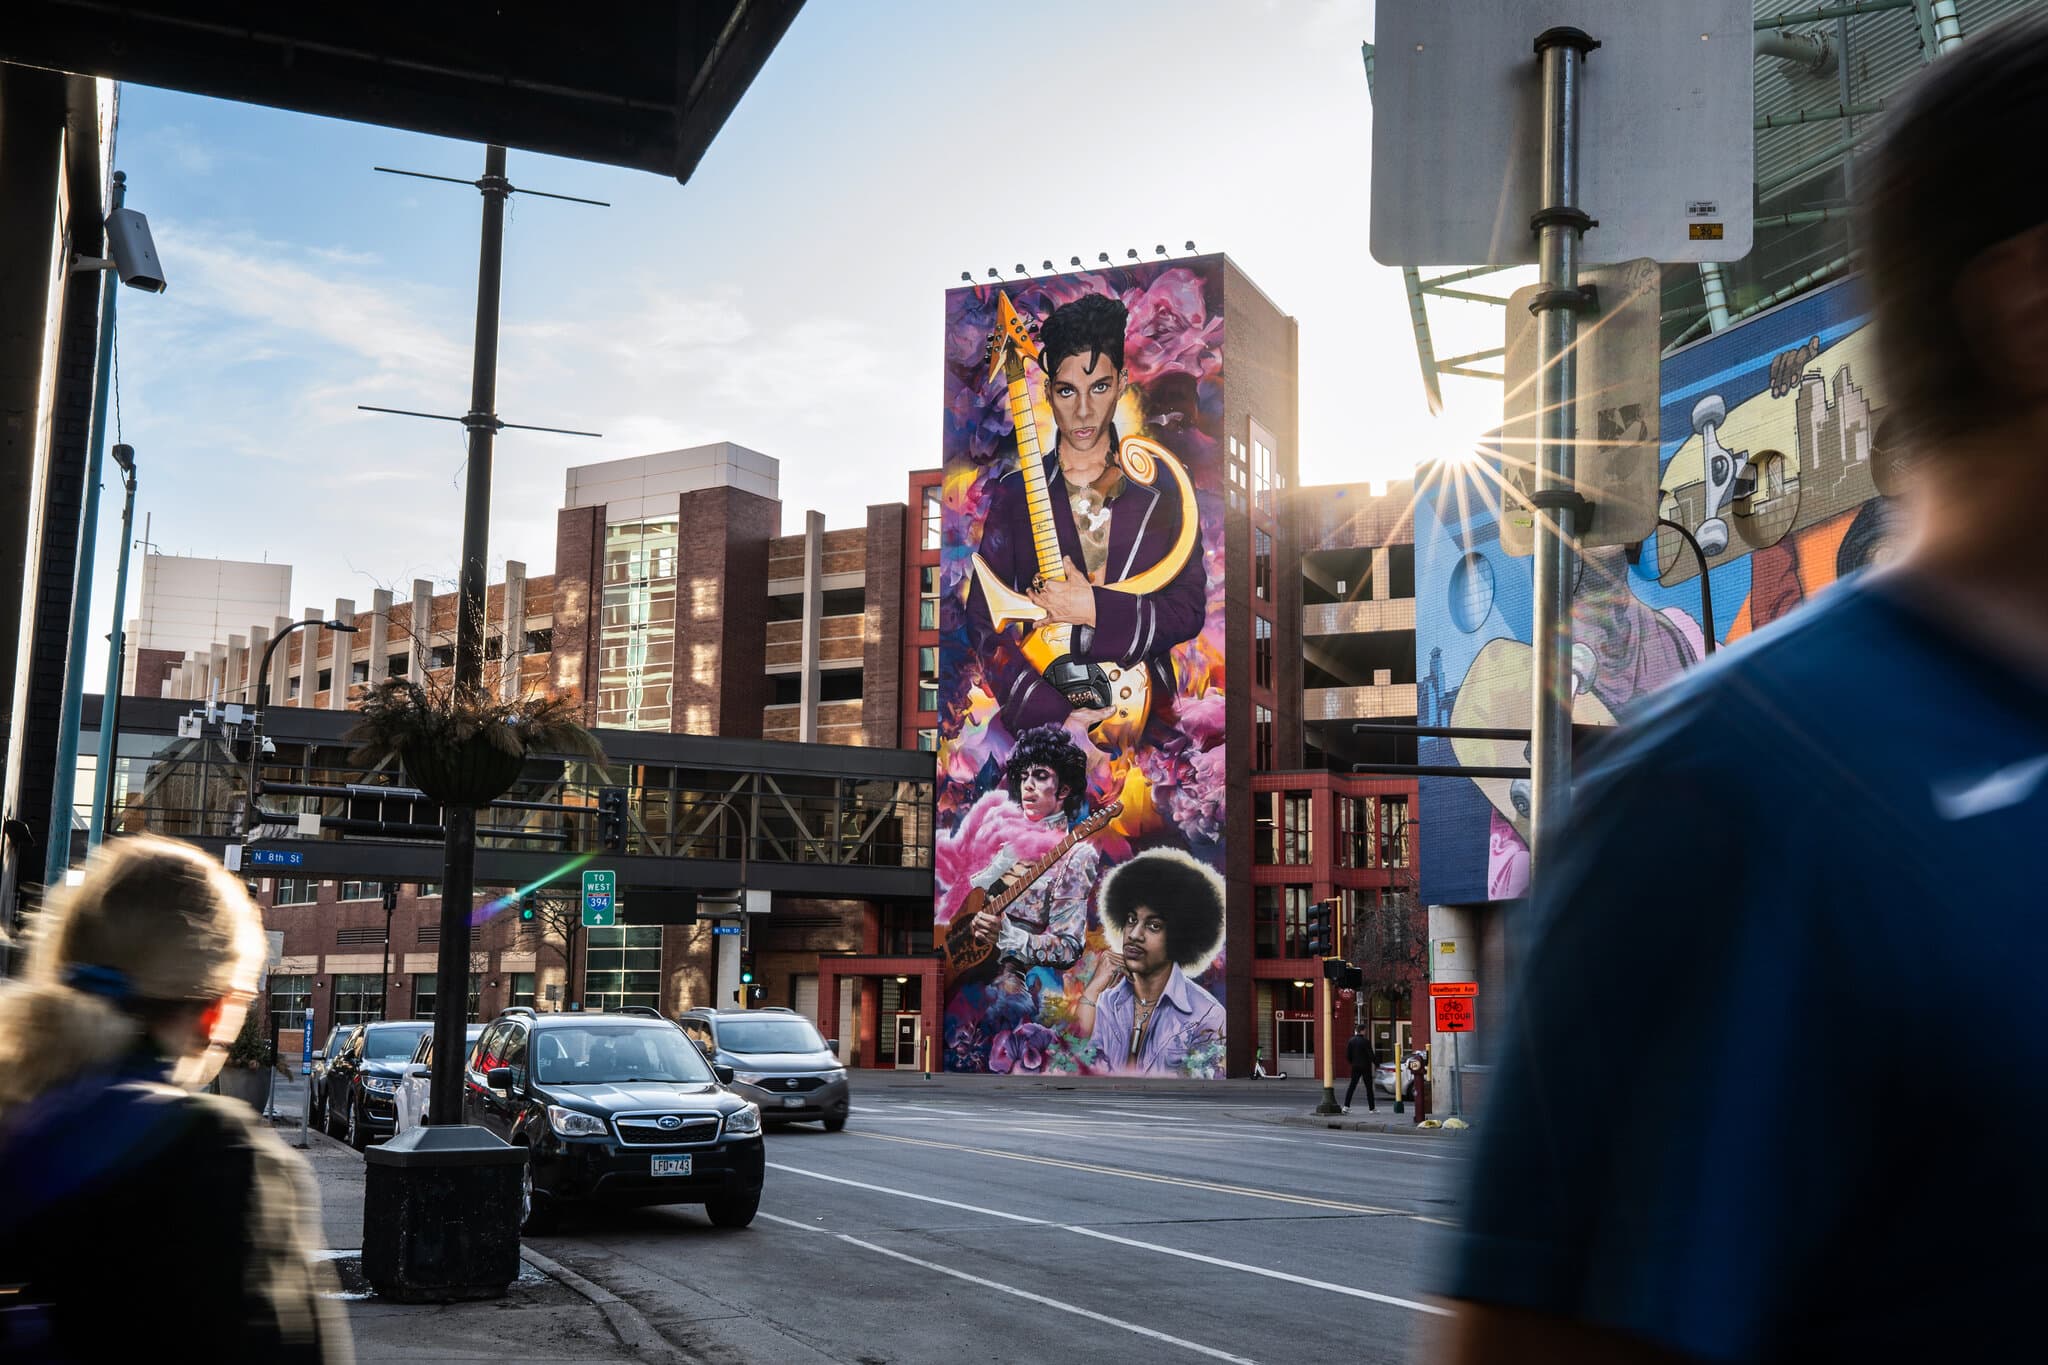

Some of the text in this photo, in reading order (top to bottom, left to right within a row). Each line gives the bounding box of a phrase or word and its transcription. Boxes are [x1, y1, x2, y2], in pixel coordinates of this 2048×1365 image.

[255, 852, 299, 863] N 8th St
[594, 874, 605, 882] TO
[587, 883, 611, 891] WEST
[590, 897, 607, 907] 394
[1439, 1012, 1471, 1021] DETOUR
